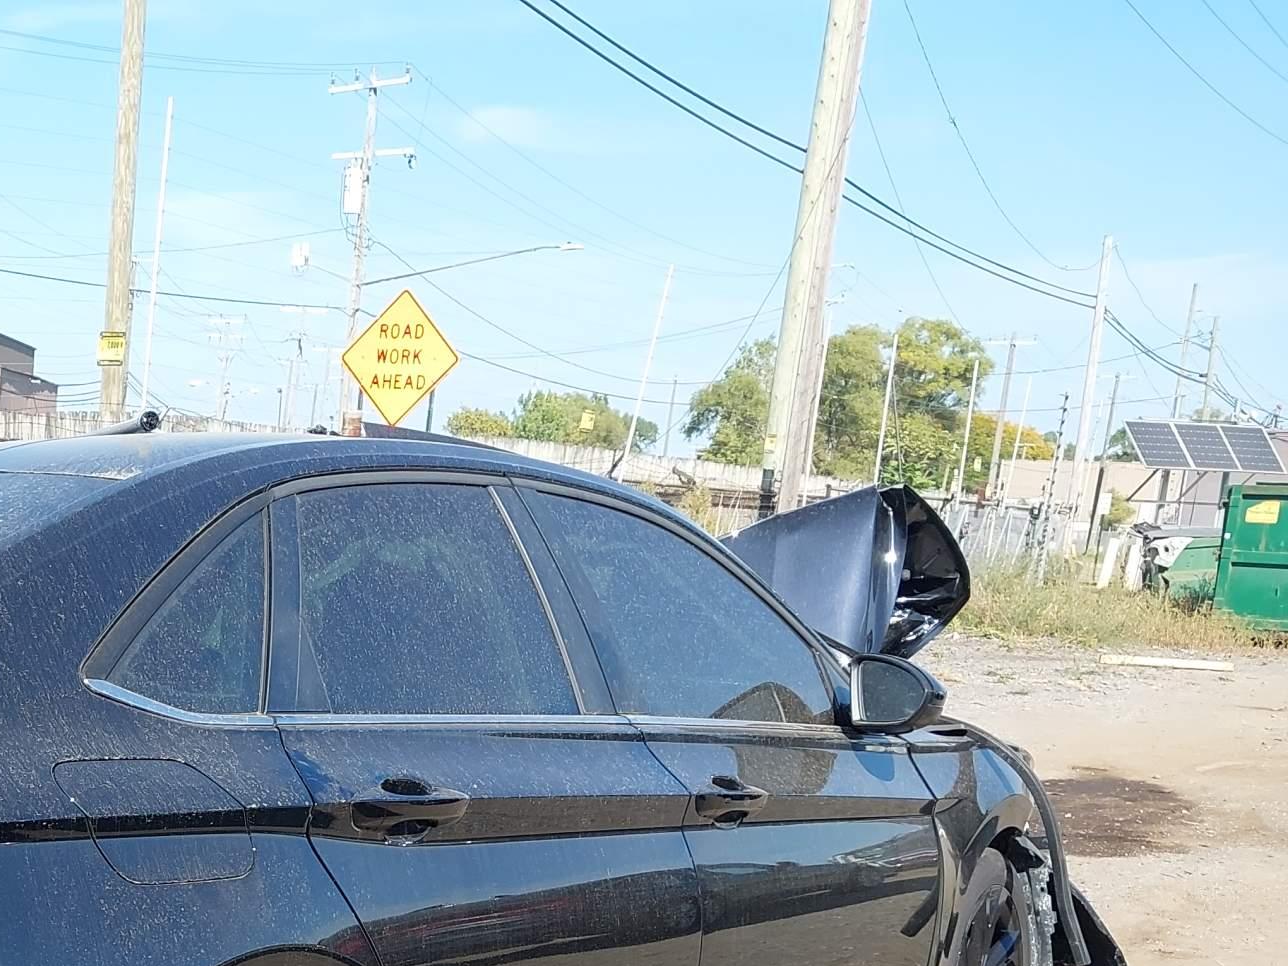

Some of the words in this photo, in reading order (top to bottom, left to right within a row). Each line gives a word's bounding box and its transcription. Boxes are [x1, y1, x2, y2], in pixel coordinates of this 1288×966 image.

[379, 323, 425, 339] ROAD
[376, 348, 423, 365] WORK
[370, 374, 426, 390] AHEAD
